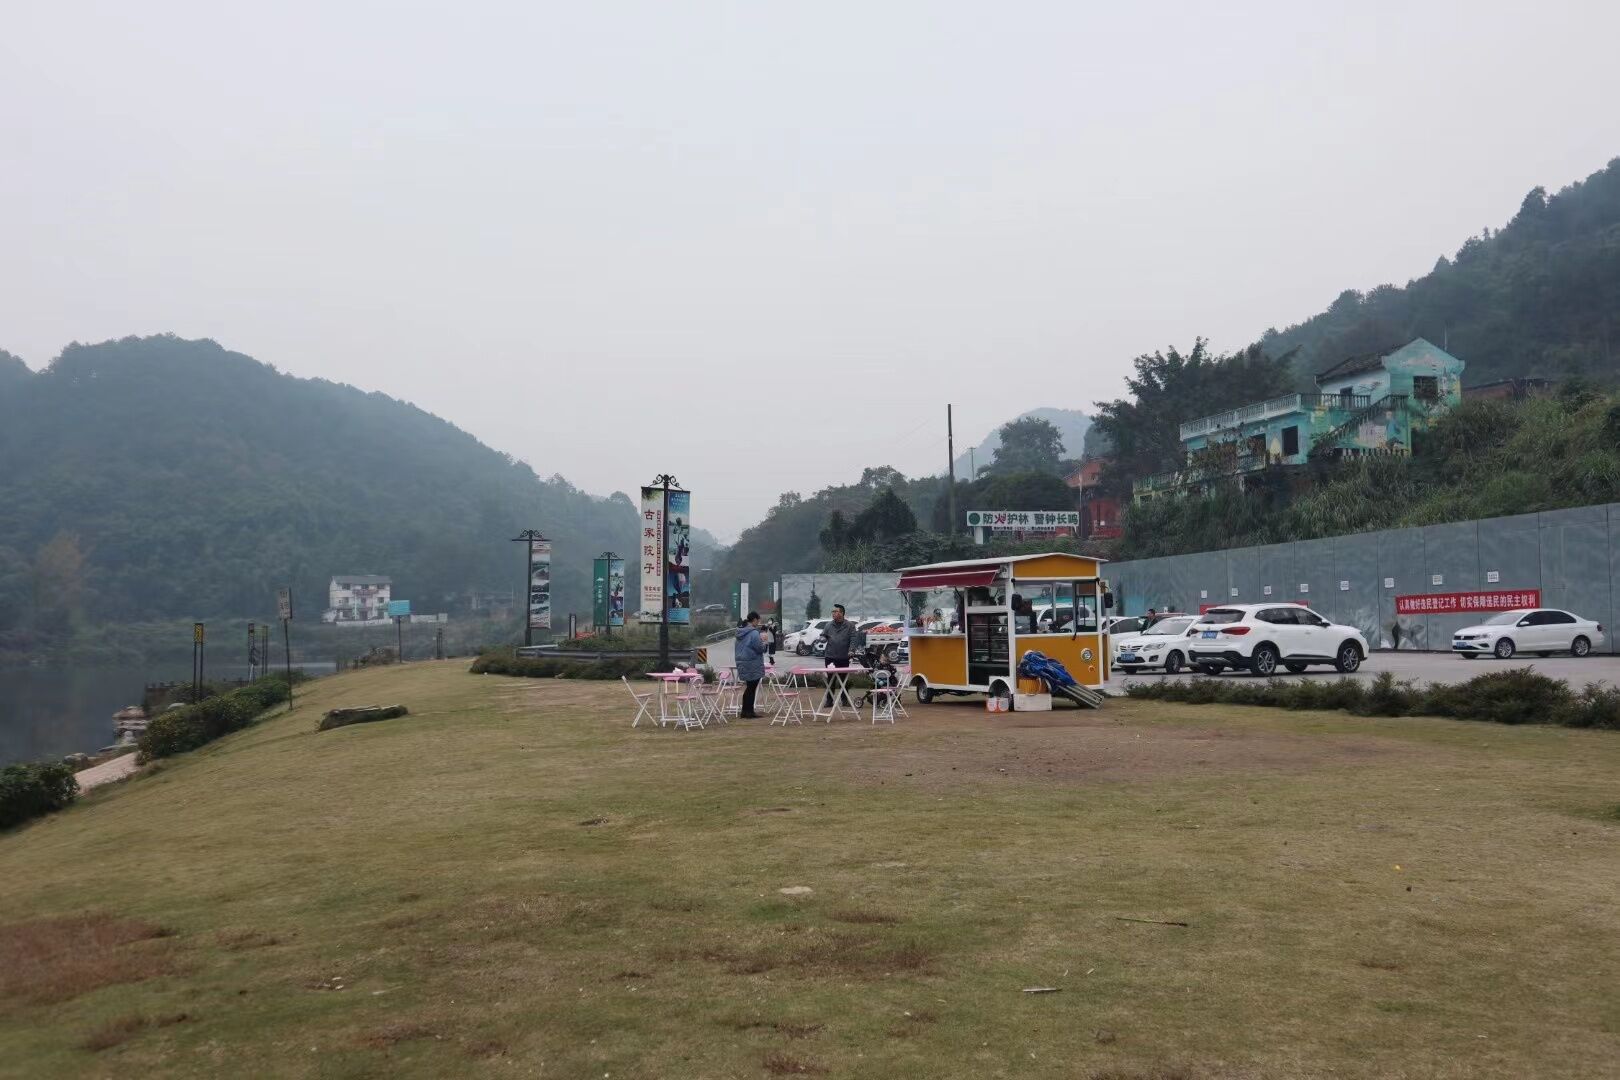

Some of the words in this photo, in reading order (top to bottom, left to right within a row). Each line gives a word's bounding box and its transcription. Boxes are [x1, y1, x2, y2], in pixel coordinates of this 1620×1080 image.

[983, 513, 1029, 525] 防火护林
[1034, 513, 1079, 525] 警钟长鸣
[1460, 593, 1536, 608] 切实保障选民的民主权利
